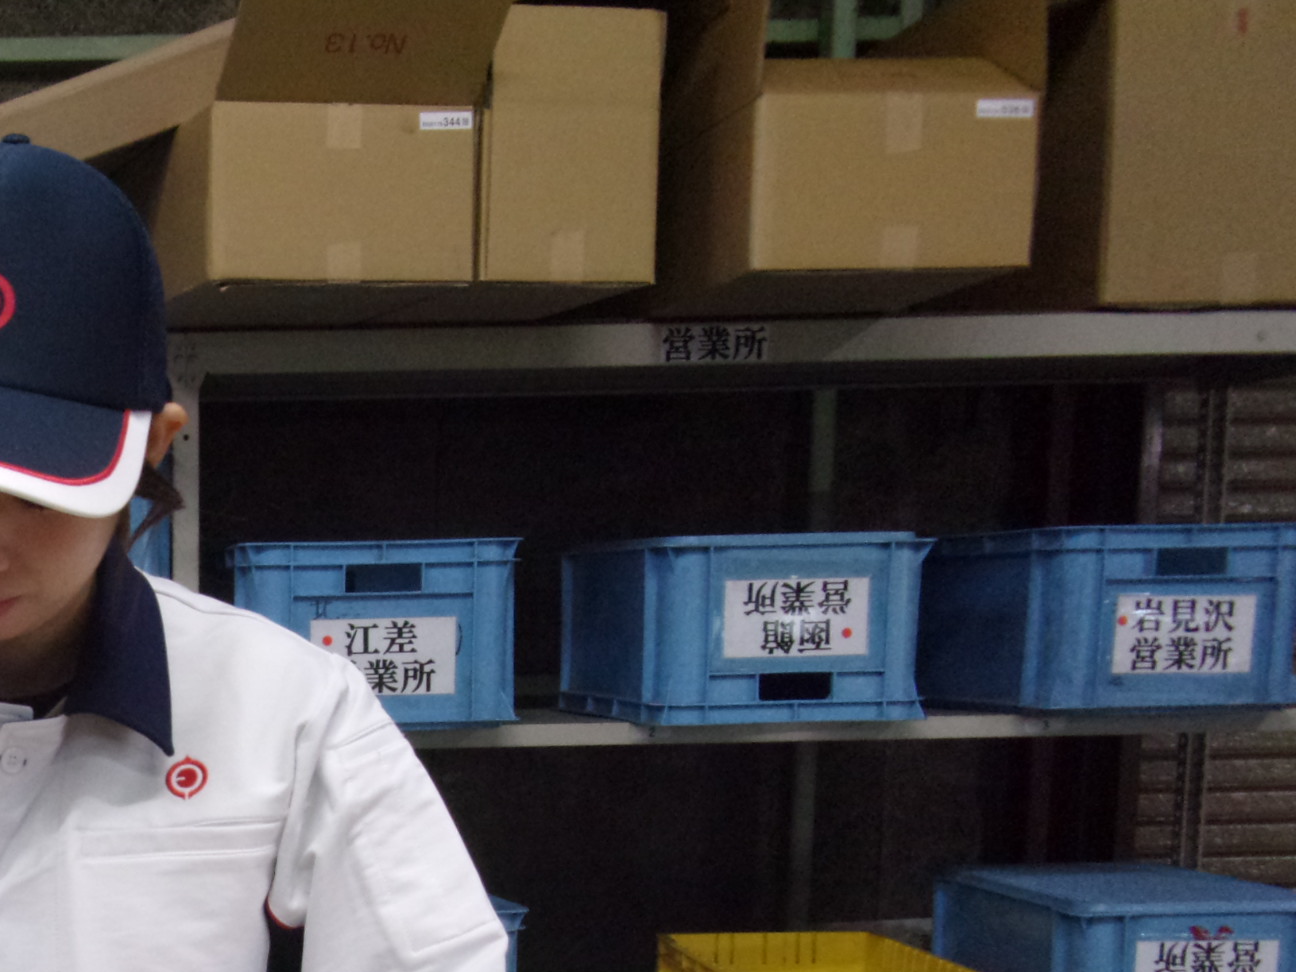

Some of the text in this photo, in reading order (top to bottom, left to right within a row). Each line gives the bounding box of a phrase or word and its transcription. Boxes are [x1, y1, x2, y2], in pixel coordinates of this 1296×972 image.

[664, 326, 769, 362] 営業所
[741, 578, 854, 614] 営業所
[1130, 595, 1236, 633] 岩見沢
[344, 623, 418, 656] 江差
[762, 619, 832, 653] 函館
[1129, 637, 1234, 671] 営業所
[360, 659, 438, 694] 業所
